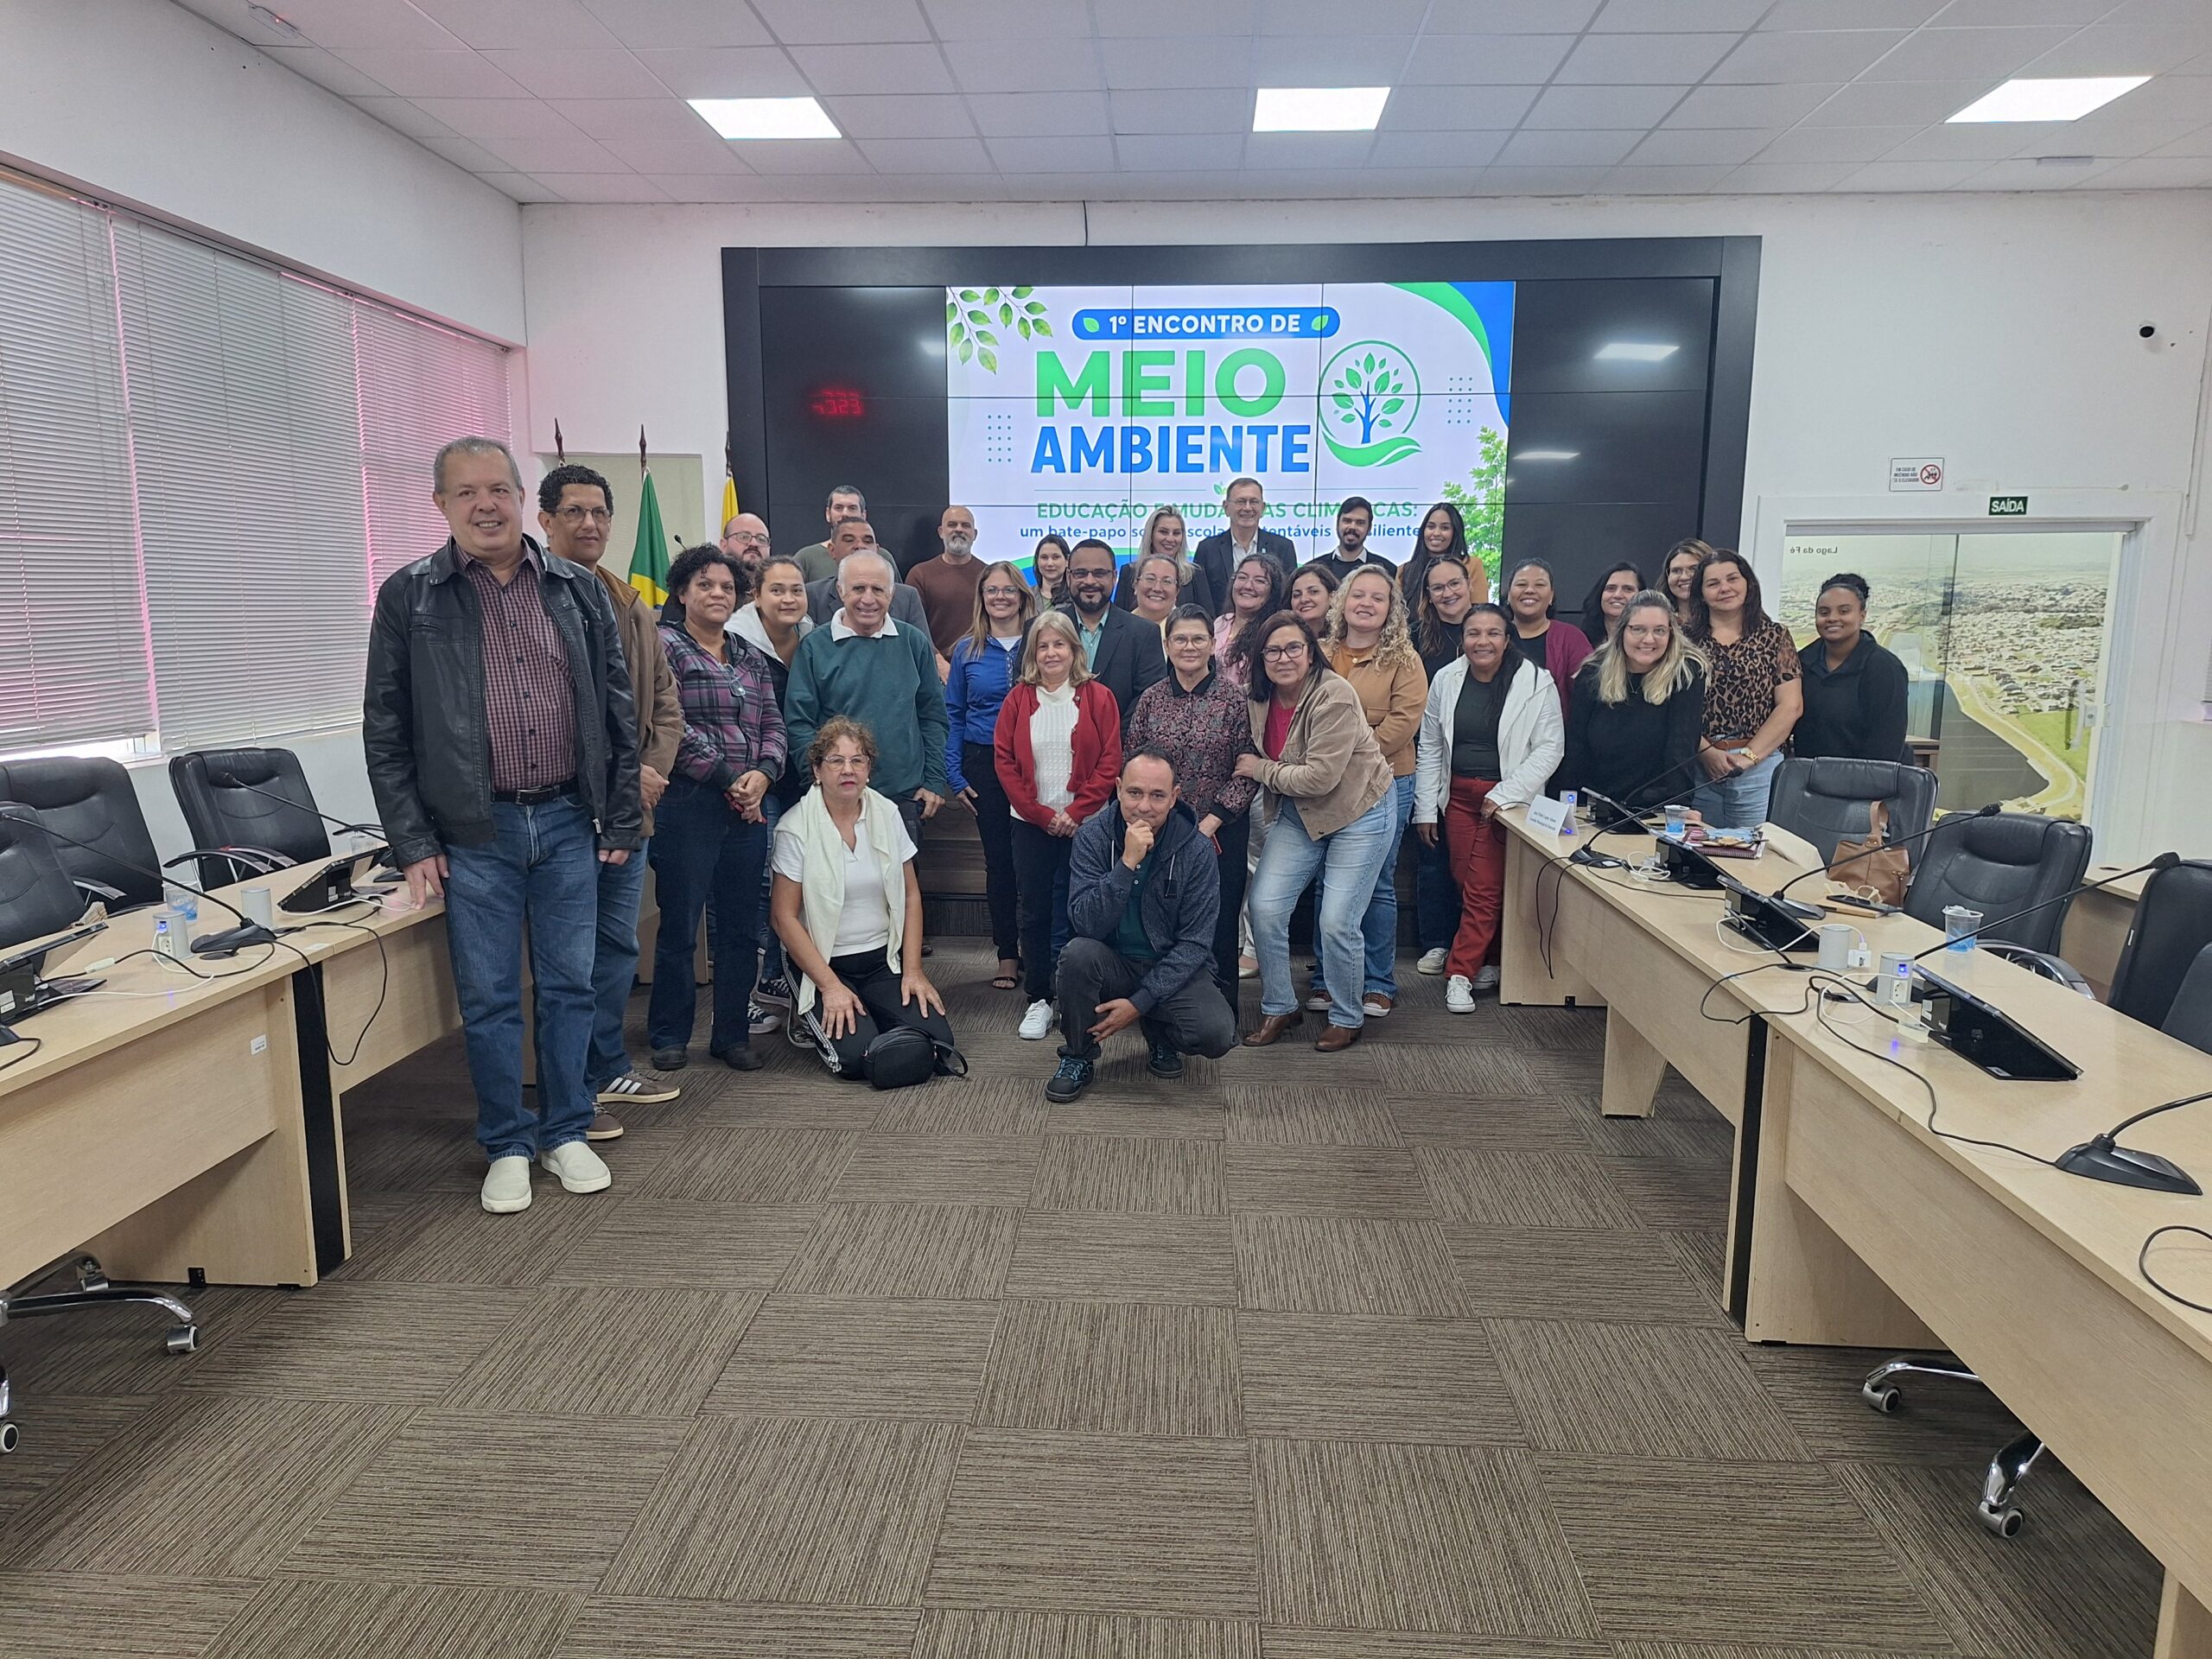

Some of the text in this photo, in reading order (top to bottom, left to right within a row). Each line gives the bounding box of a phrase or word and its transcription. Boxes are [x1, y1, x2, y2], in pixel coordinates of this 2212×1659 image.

[1133, 315, 1264, 334] ENCONTRO
[1271, 315, 1300, 333] DE
[1036, 347, 1286, 417] MEIO
[1031, 424, 1311, 474] AMBIENTE
[1037, 499, 1147, 522] EDUCAÇÃO
[1173, 503, 1287, 518] MUDAAS
[1293, 502, 1417, 518] CLIMCAS:
[1991, 498, 2024, 512] SAÍDA
[1020, 528, 1044, 537] um
[1049, 525, 1127, 540] bate-papo
[1186, 525, 1226, 537] scola
[1368, 524, 1422, 537] iliente
